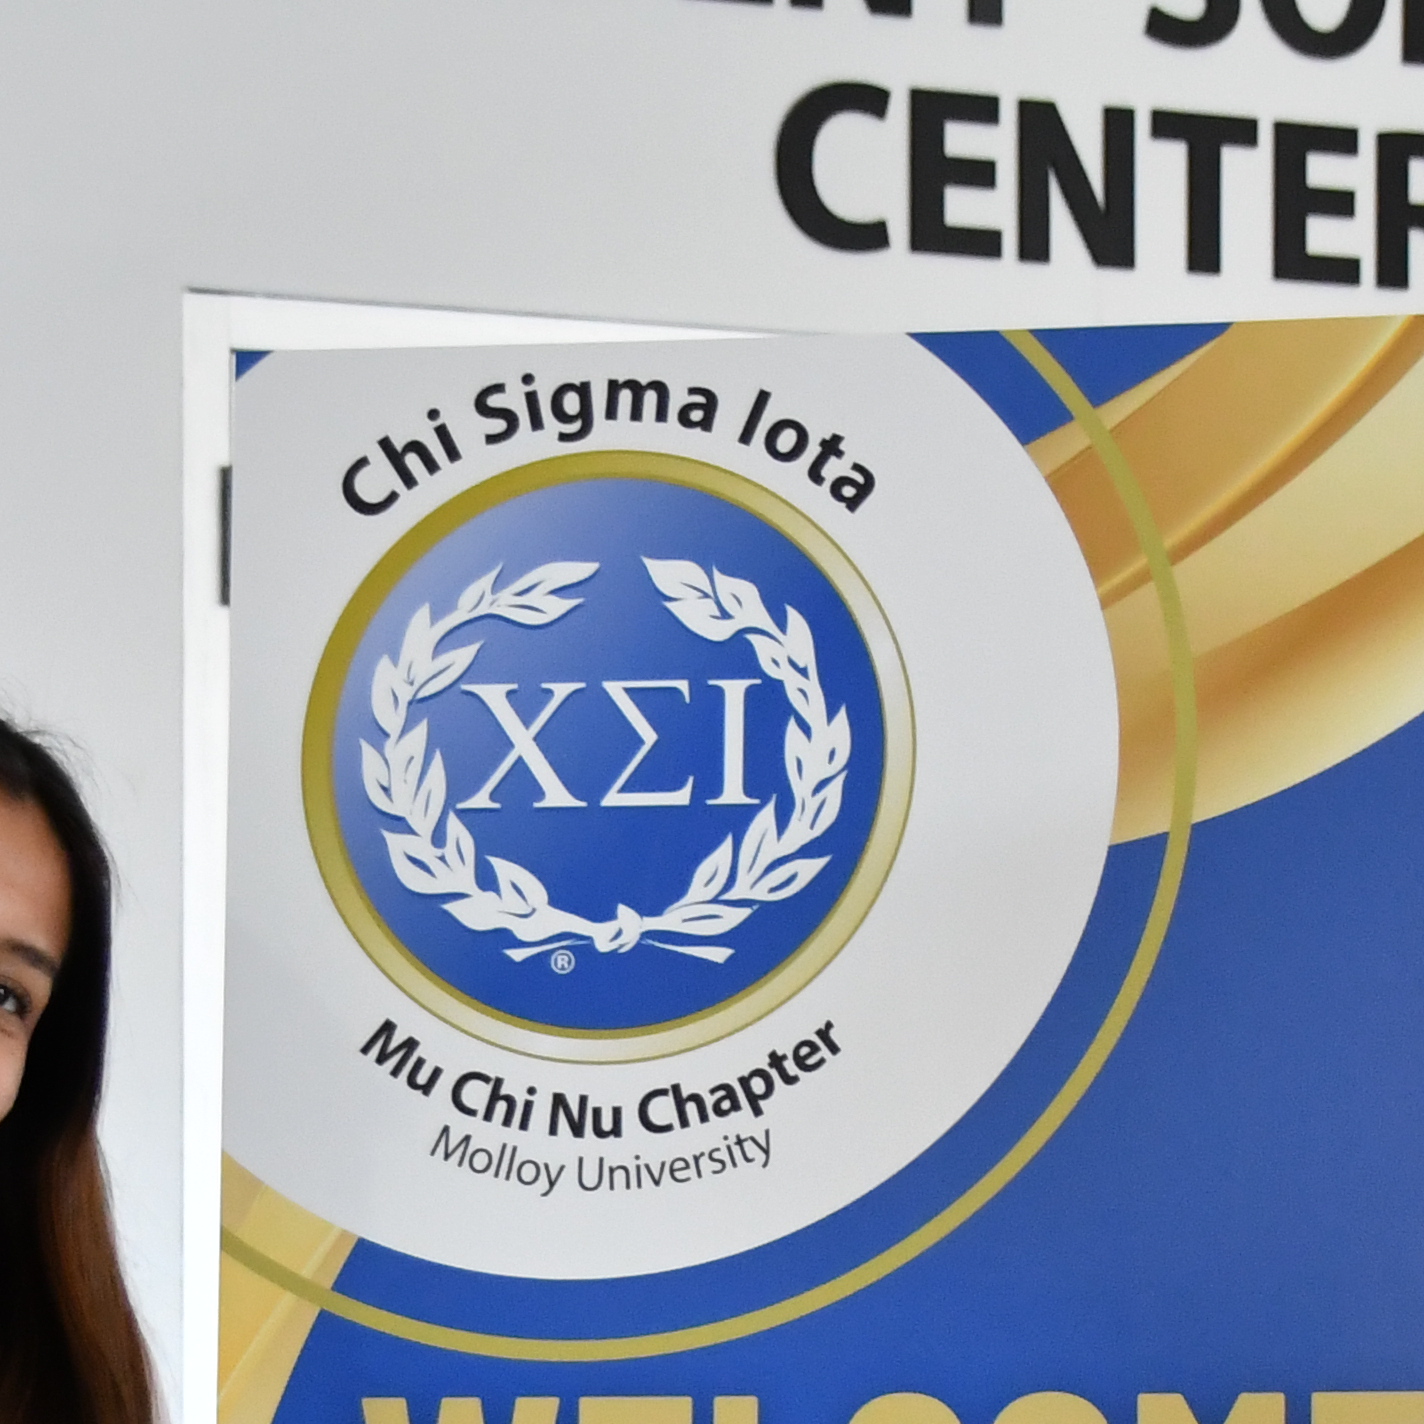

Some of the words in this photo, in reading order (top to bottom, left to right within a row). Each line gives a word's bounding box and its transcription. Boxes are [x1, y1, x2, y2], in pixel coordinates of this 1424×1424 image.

[341, 408, 463, 517] Chi
[474, 372, 719, 444] Sigma
[737, 389, 877, 514] Iota
[359, 1018, 444, 1098] Mu
[450, 1070, 536, 1133] Chi
[548, 1092, 624, 1139] Nu
[636, 1018, 843, 1135] Chapter
[429, 1124, 565, 1198] Molloy
[576, 1126, 773, 1192] University
